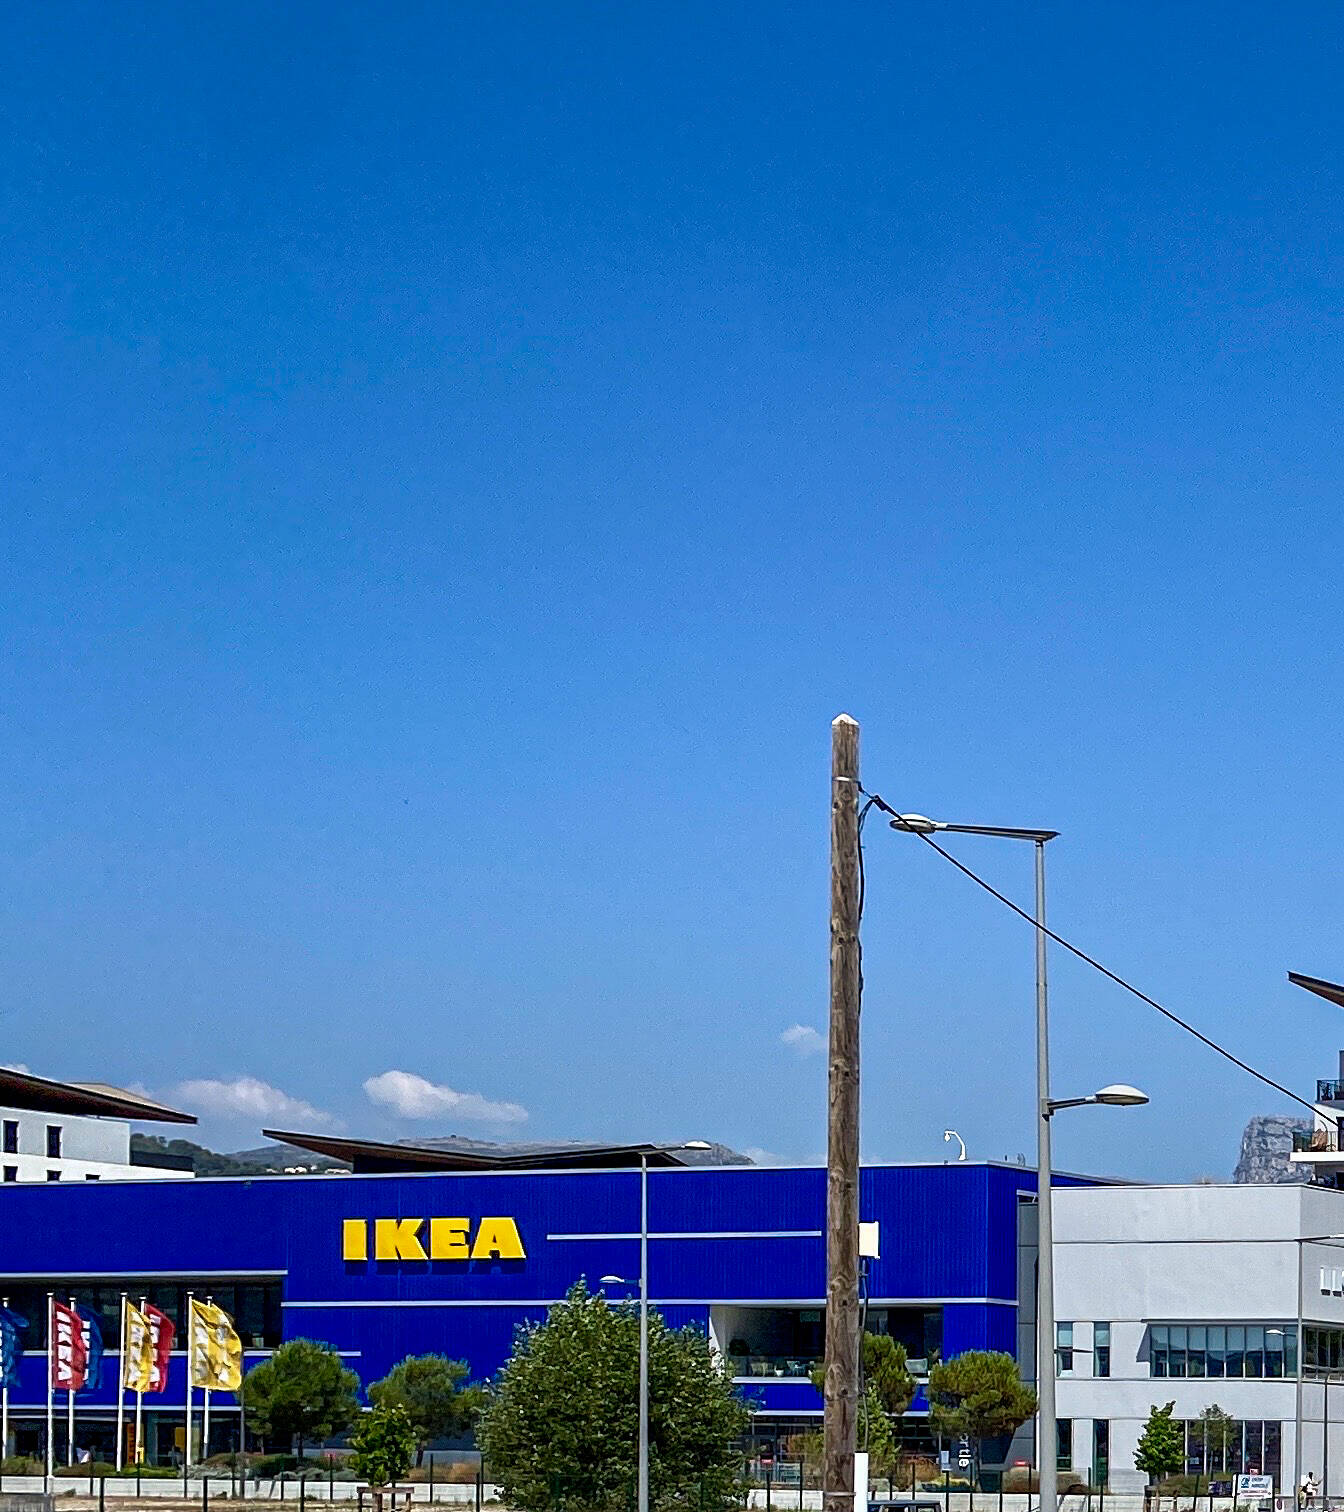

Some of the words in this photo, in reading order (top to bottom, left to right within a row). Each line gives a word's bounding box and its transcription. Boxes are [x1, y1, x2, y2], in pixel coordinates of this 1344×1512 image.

[343, 1217, 526, 1260] IKEA
[56, 1311, 73, 1381] IKEA
[959, 1431, 972, 1467] ortie
